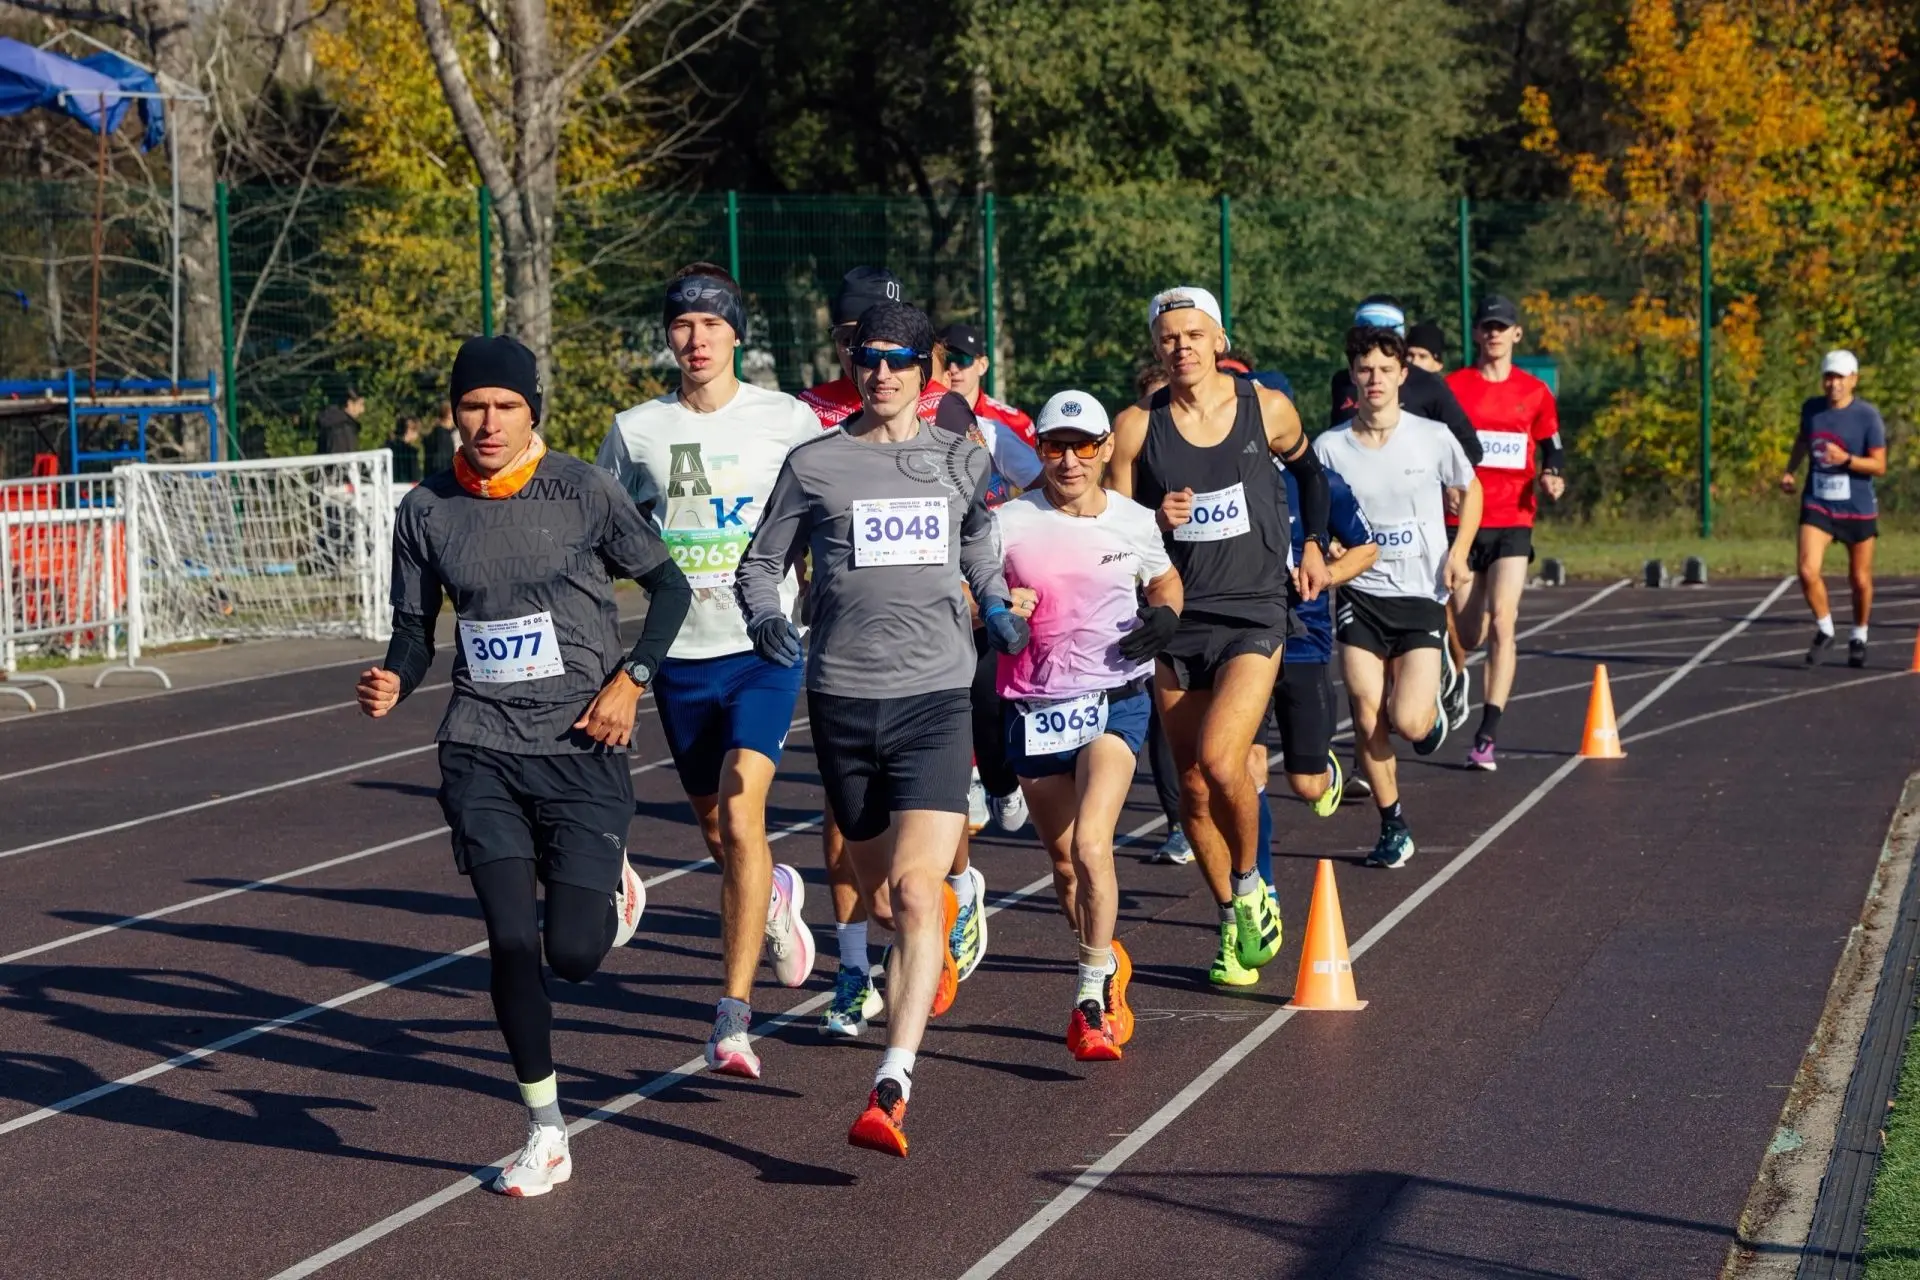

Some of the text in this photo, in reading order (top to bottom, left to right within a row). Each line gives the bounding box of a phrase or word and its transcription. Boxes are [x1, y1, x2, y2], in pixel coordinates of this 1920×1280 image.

[886, 281, 900, 302] 01
[1482, 441, 1520, 455] 3049
[1186, 500, 1239, 525] 066
[865, 515, 940, 542] 3048
[1373, 530, 1413, 546] 050
[673, 542, 740, 568] 2963
[472, 631, 542, 661] 3077
[1035, 706, 1099, 734] 3063
